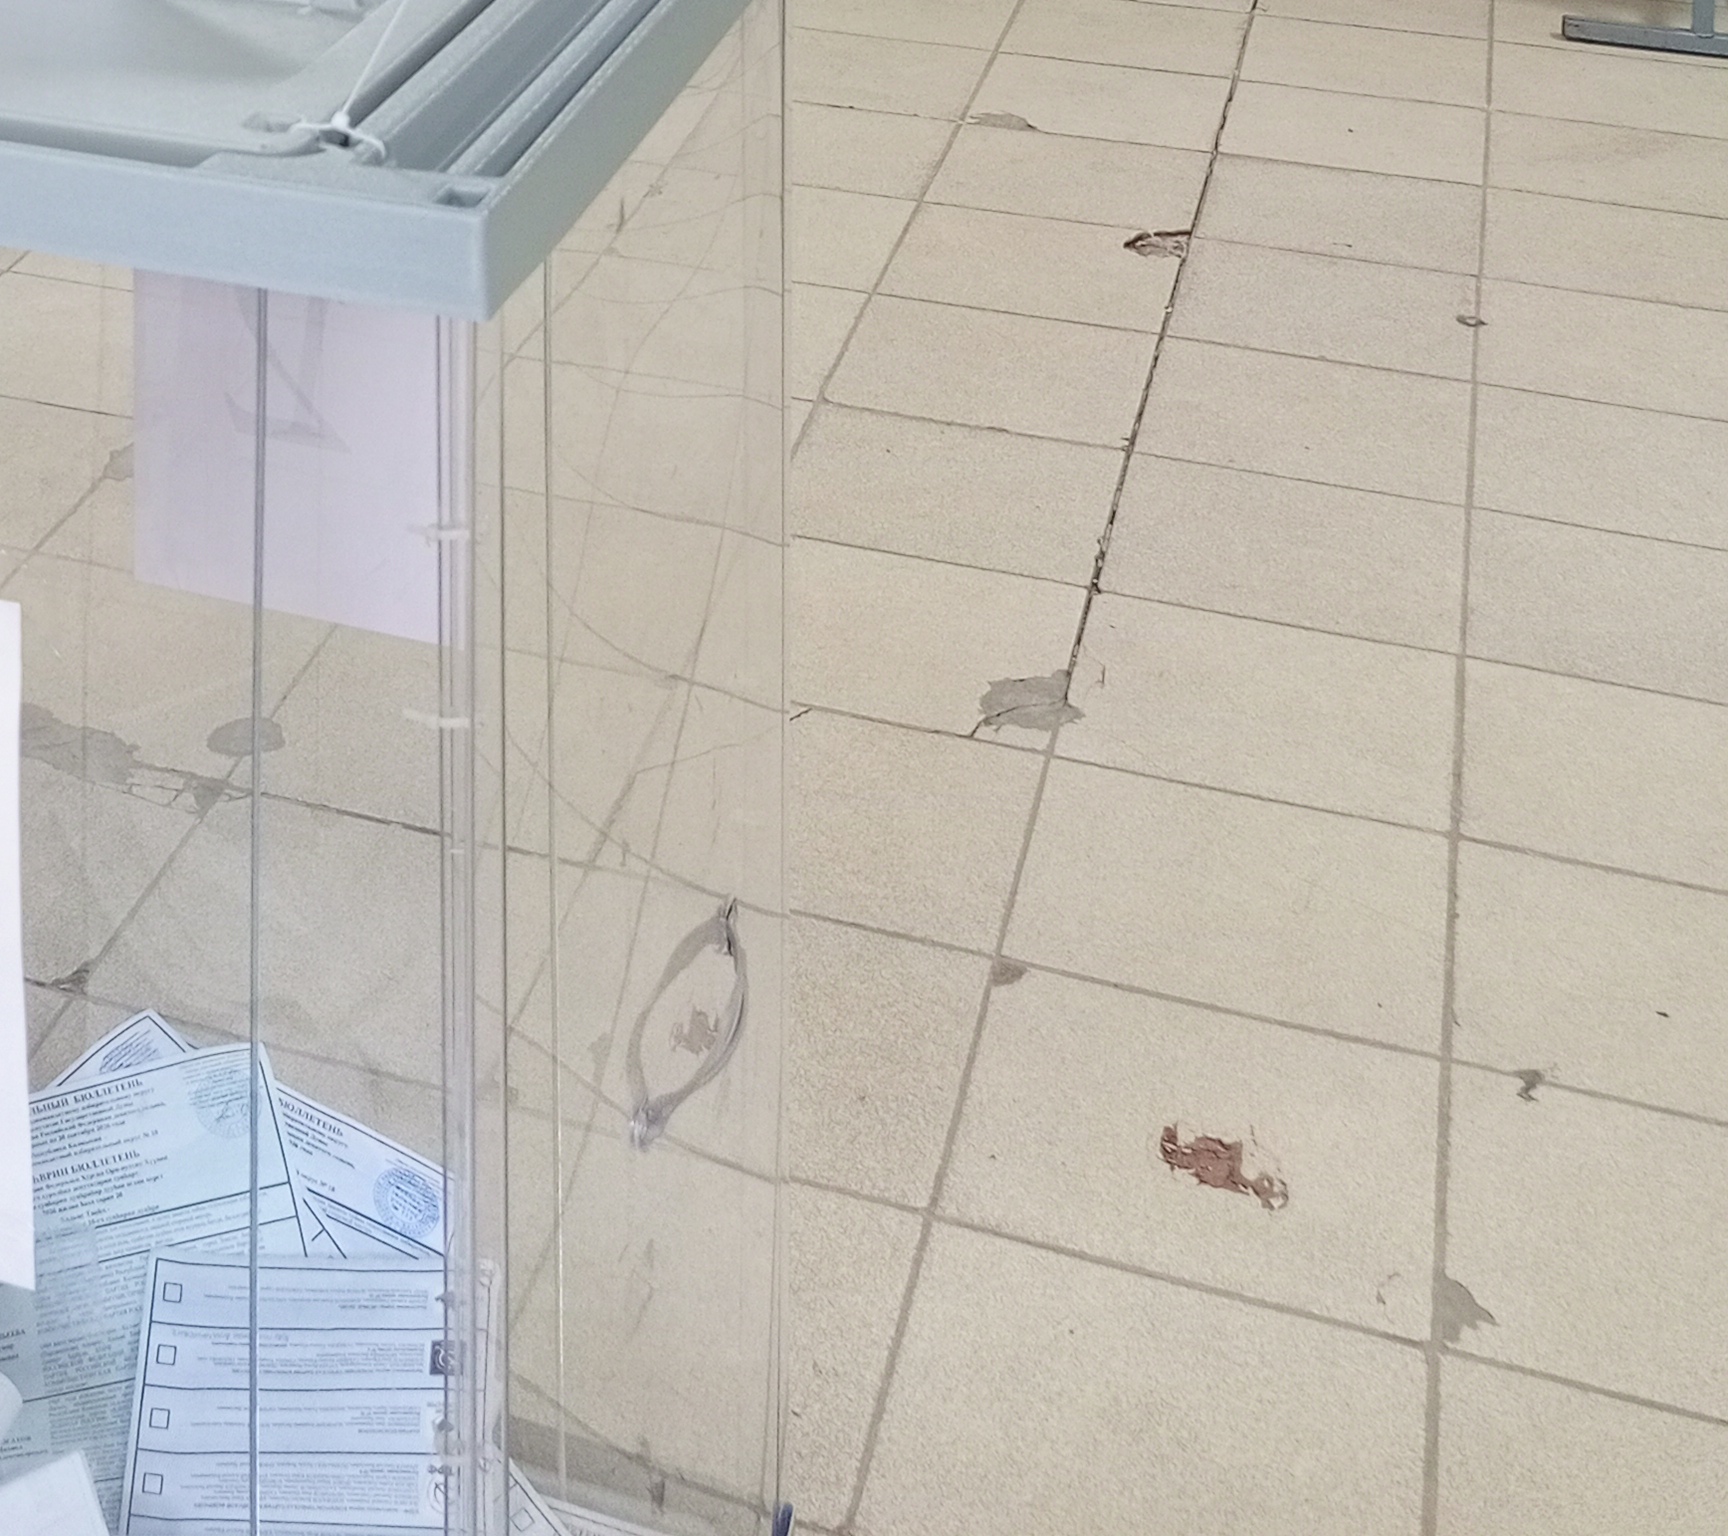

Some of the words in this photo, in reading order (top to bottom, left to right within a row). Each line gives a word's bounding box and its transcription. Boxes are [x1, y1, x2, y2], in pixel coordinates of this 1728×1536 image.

[31, 1097, 69, 1116] ЛЬНЫЙ
[73, 1077, 144, 1105] БЮЛЛЕТЕНЬ
[70, 1149, 141, 1175] БЮЛЛЕТЕНЬ
